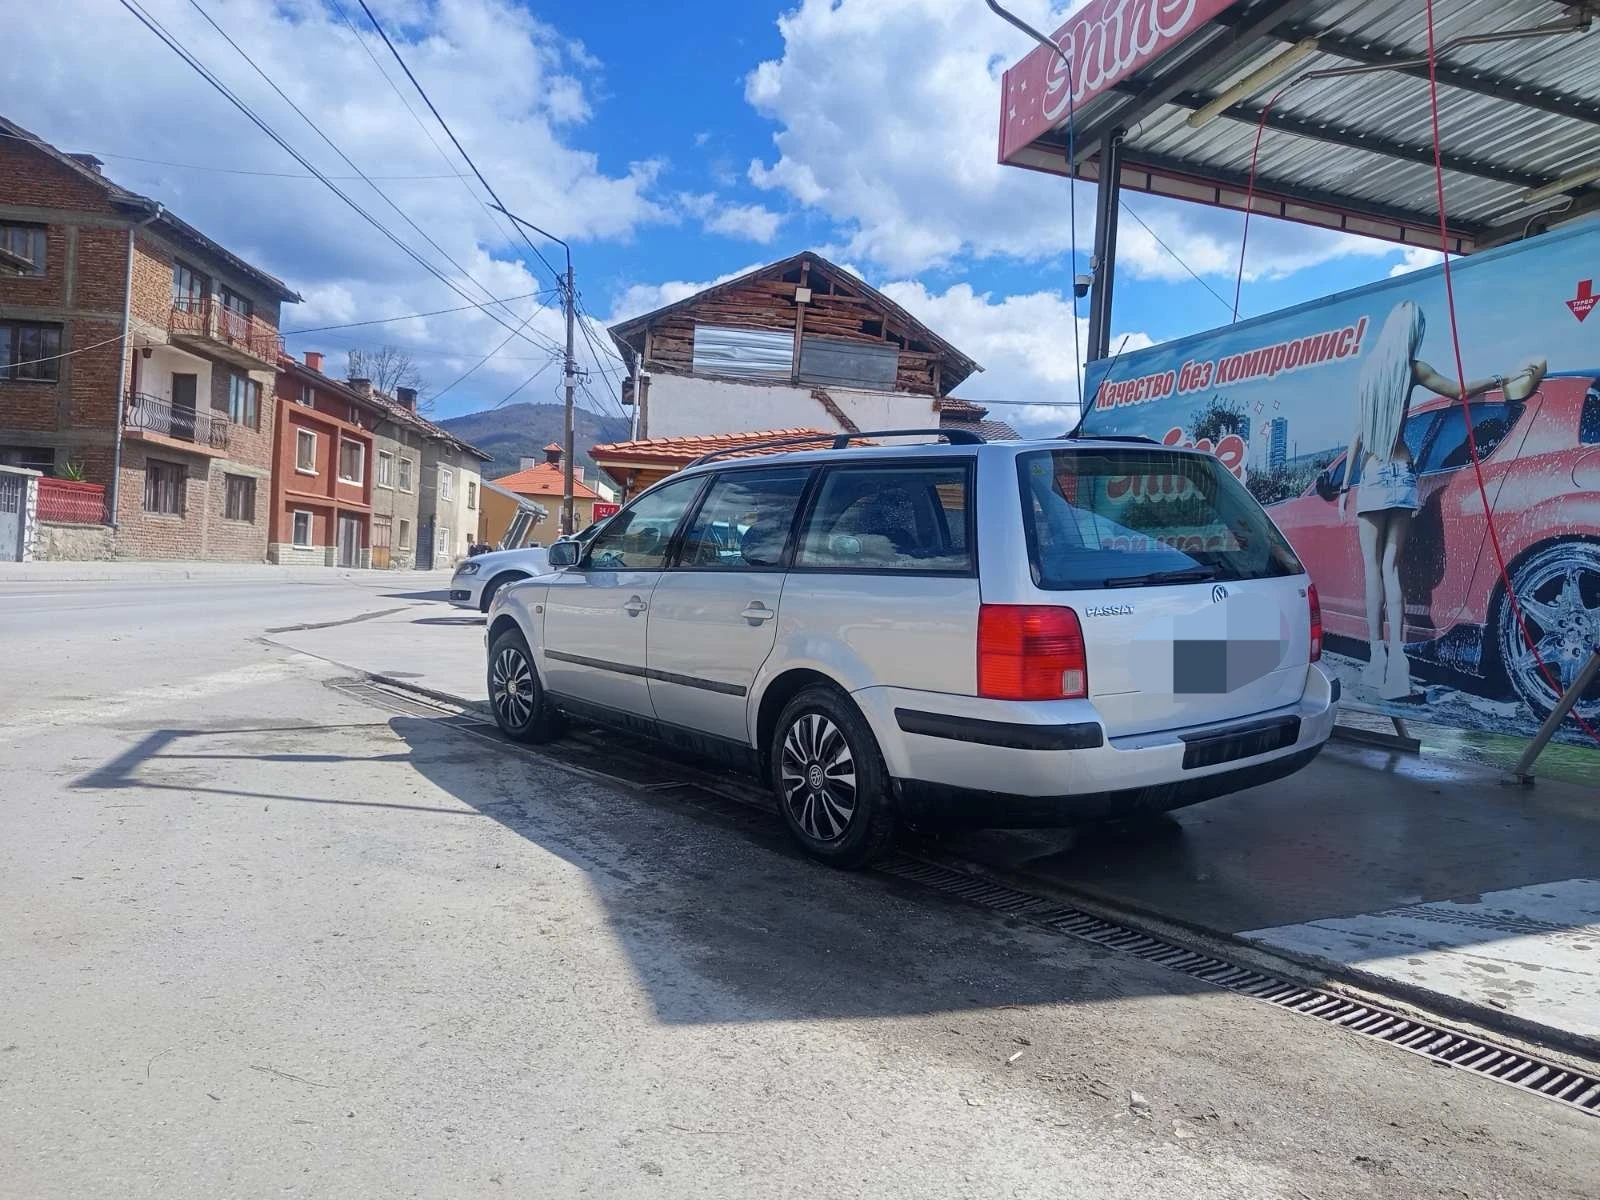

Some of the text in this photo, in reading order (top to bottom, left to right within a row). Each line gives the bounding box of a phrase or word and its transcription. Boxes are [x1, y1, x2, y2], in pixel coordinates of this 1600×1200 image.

[1096, 317, 1368, 409] Качество без компромис!
[1085, 604, 1135, 617] PASSAT
